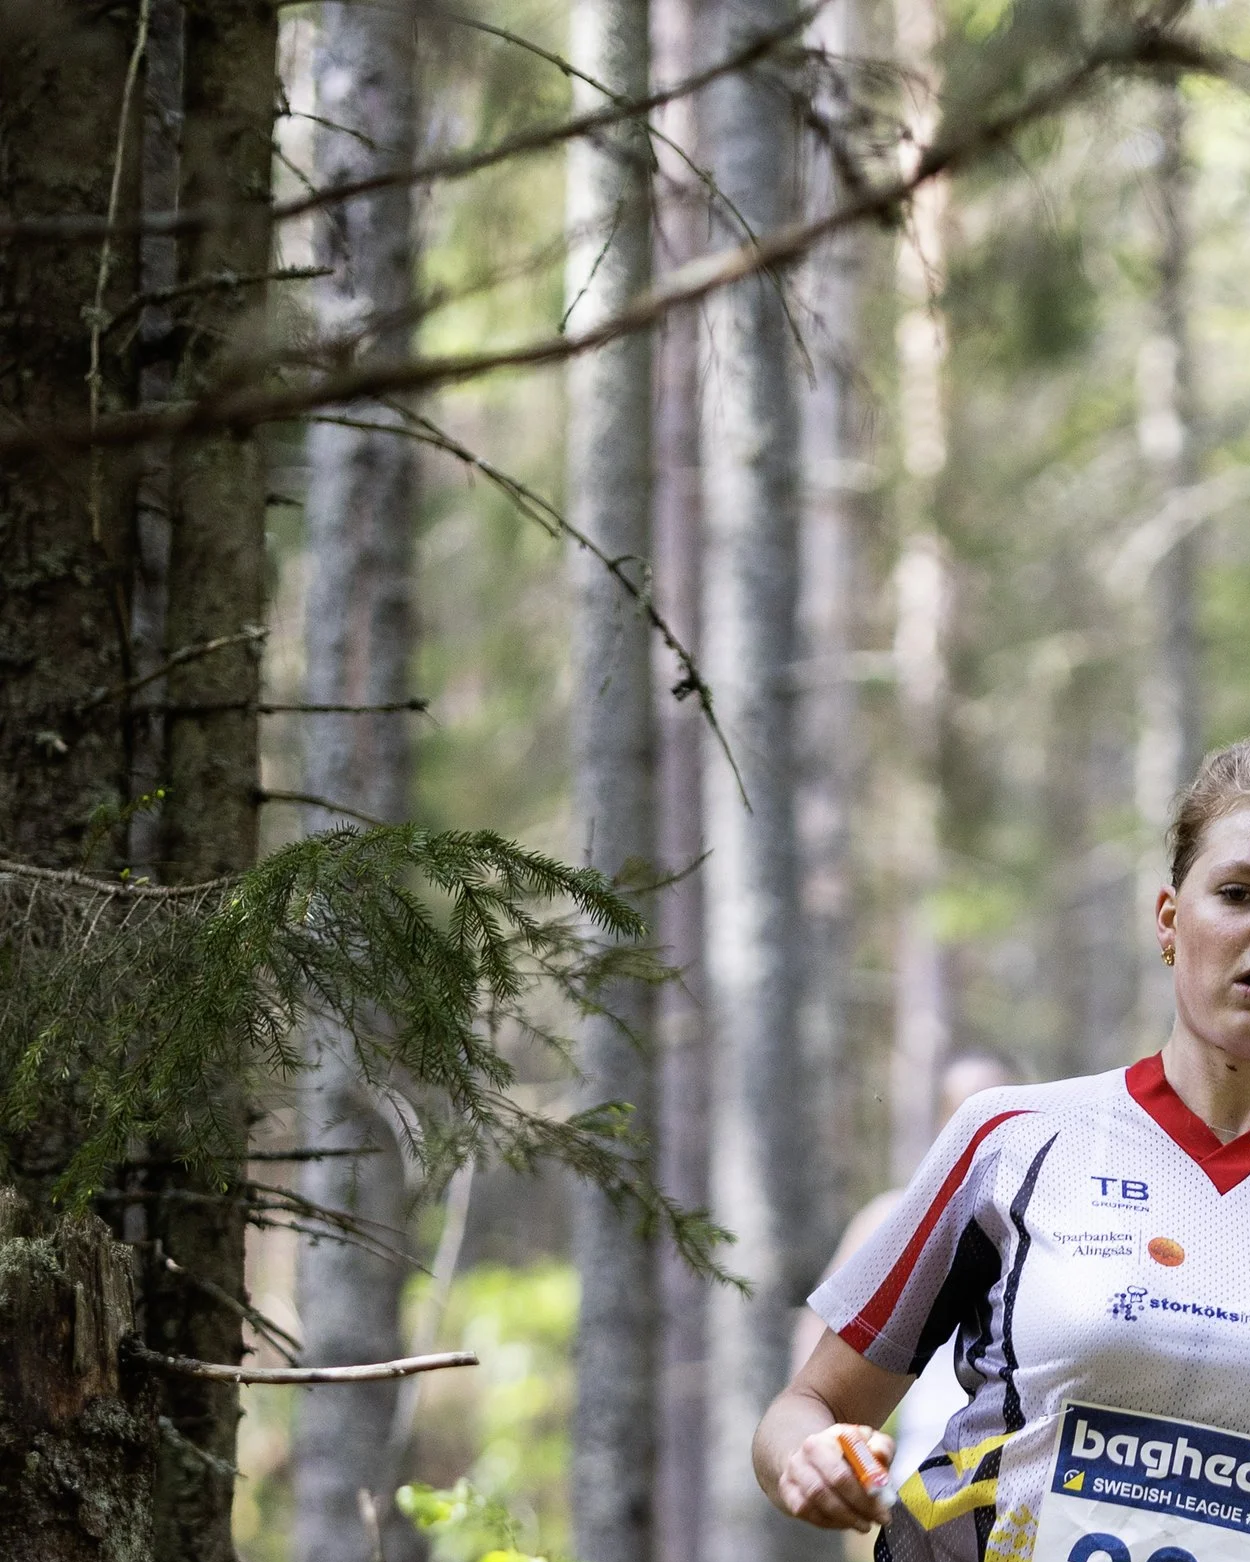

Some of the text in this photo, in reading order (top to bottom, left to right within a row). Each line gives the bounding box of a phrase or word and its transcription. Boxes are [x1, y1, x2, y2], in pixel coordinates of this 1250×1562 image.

[1091, 1176, 1149, 1201] TB
[1053, 1231, 1133, 1244] Sparbanken
[1072, 1245, 1133, 1258] Alingsås
[1093, 1478, 1172, 1505] SWEDISH
[1176, 1495, 1242, 1524] LEAGUE
